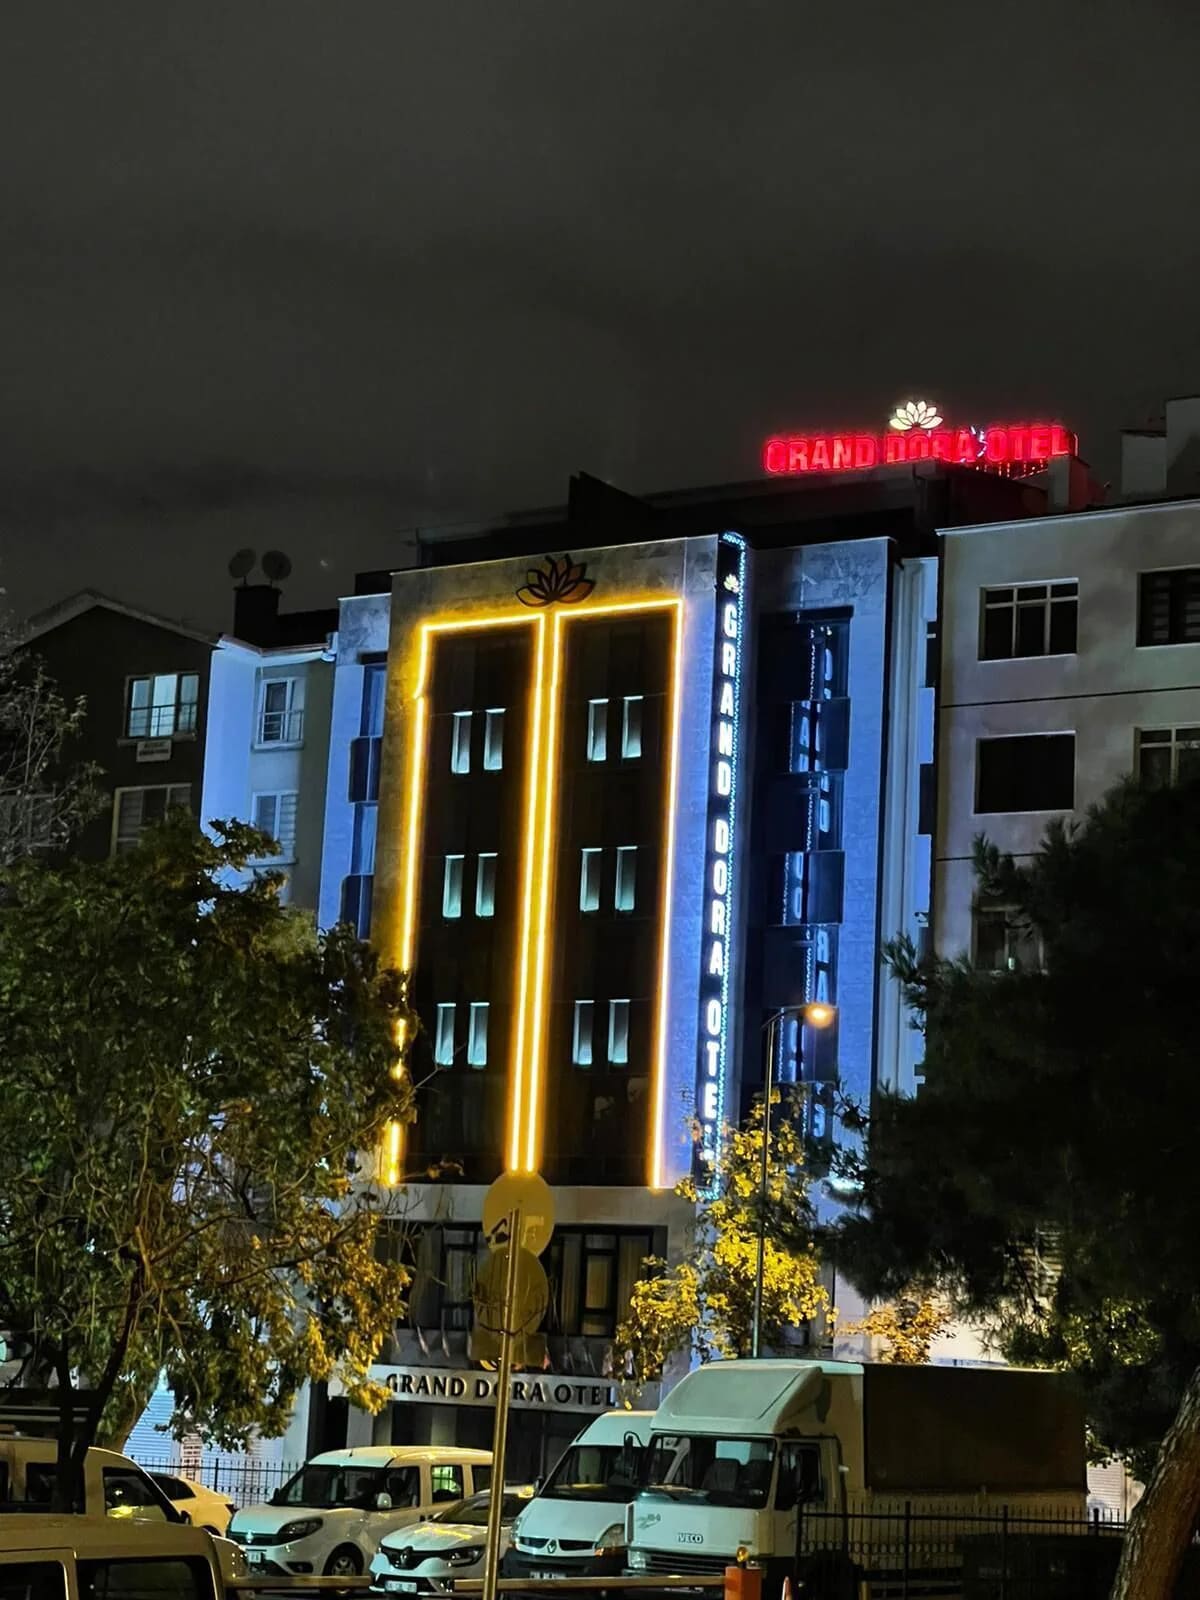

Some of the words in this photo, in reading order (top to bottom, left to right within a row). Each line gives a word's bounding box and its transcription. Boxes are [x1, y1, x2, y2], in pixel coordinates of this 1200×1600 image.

[766, 437, 876, 472] GRAND
[884, 431, 976, 463] DORA
[986, 426, 1069, 462] OTEL
[717, 603, 737, 796] GRAND
[709, 819, 729, 975] DORA
[386, 1373, 466, 1397] GRAND
[475, 1379, 545, 1402] DRA
[554, 1384, 617, 1407] OTEL
